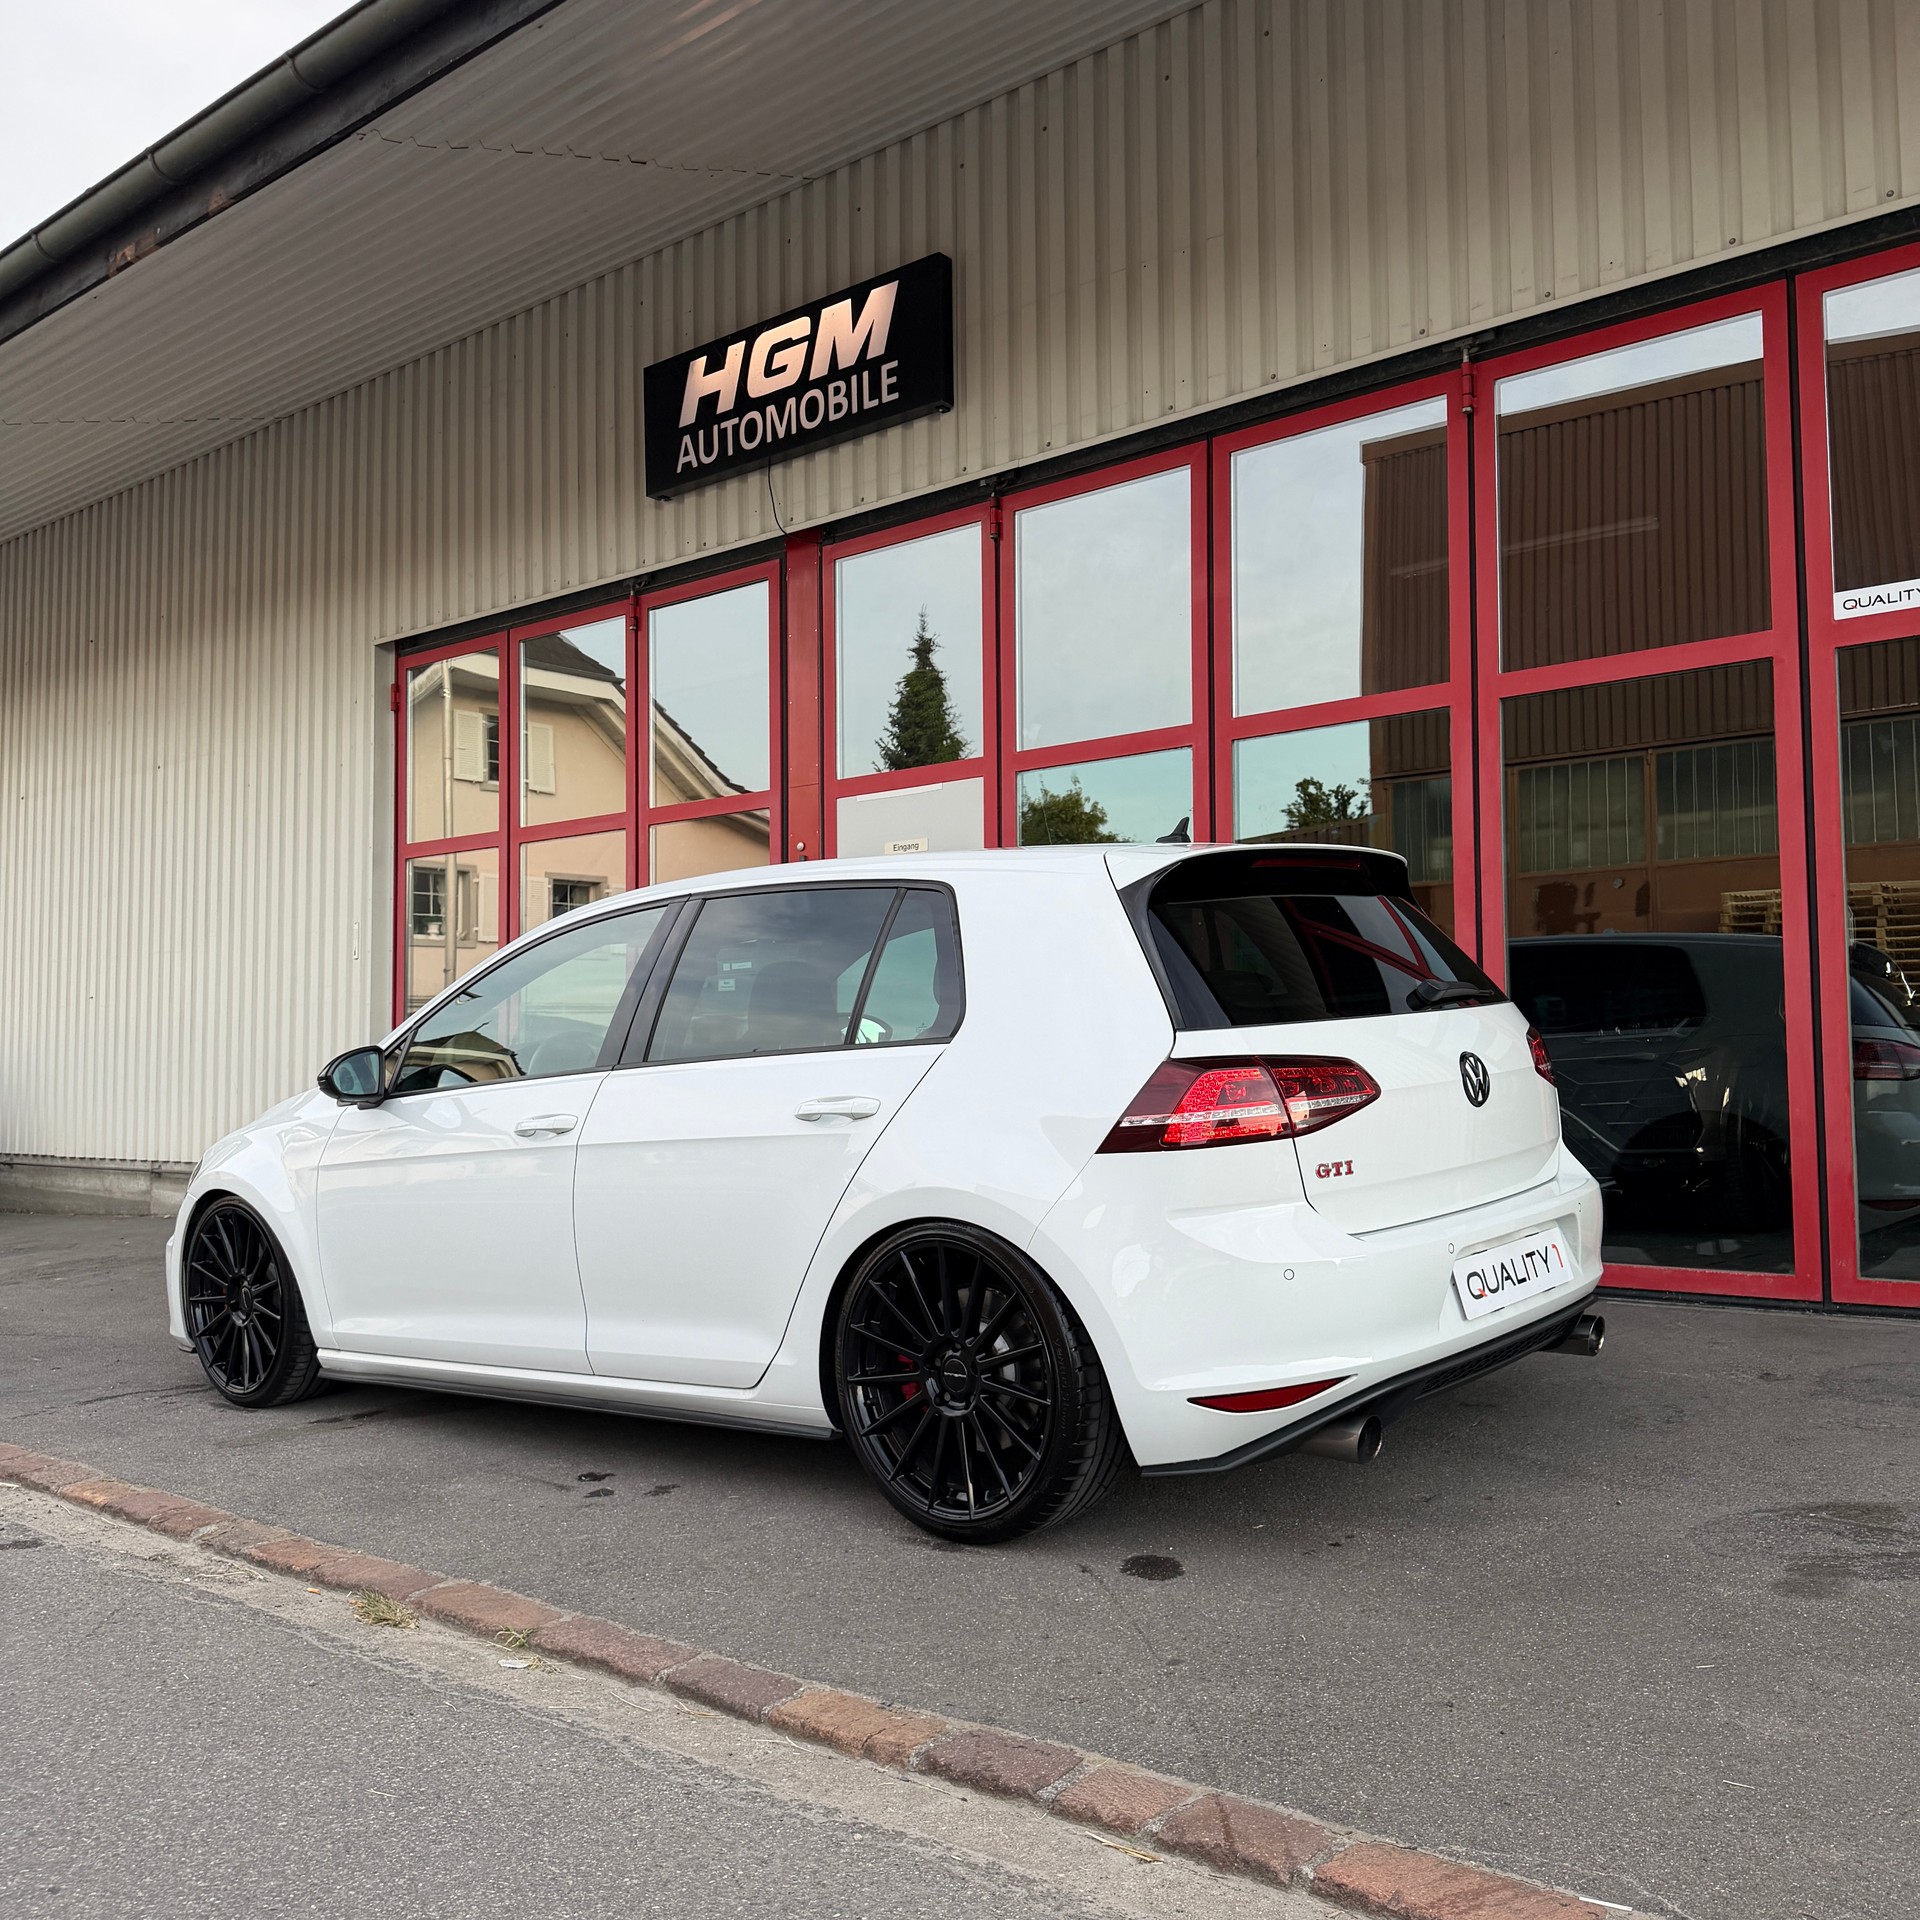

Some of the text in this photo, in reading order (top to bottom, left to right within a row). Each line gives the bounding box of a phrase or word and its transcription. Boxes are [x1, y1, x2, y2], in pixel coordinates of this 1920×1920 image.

[678, 280, 899, 428] HGM
[676, 360, 899, 473] AUTOMOBILE
[893, 843, 919, 852] Eingang
[1315, 1159, 1354, 1179] GTI
